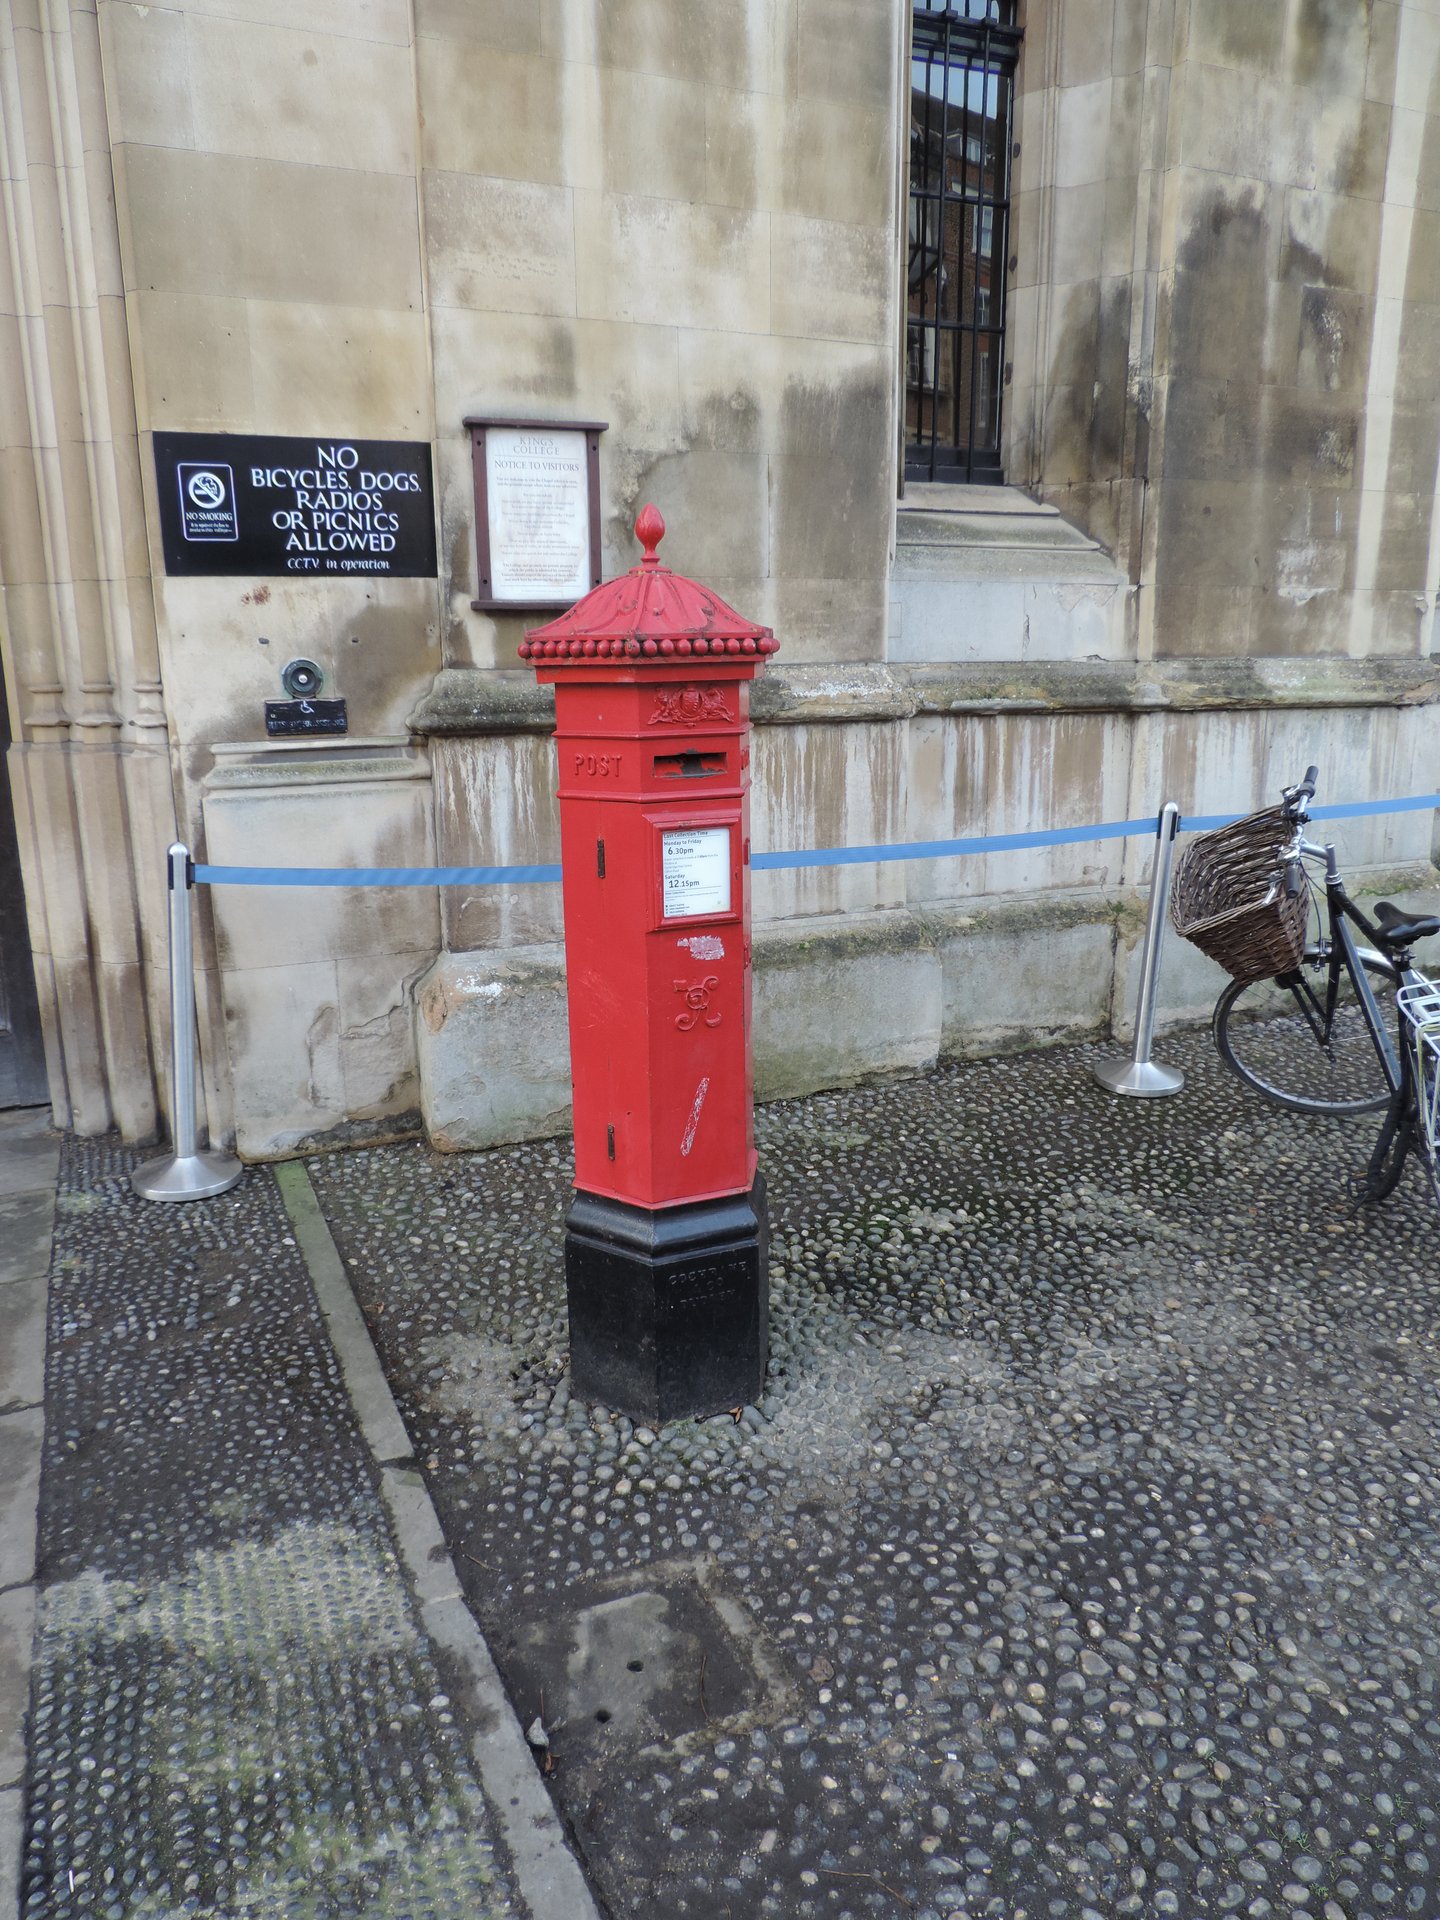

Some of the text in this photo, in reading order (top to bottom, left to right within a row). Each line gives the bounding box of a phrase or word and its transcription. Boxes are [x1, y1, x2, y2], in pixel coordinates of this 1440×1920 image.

[317, 446, 359, 470] NO
[513, 446, 560, 455] COLLEGE
[494, 460, 580, 472] NOTICE TO VISITORS
[360, 471, 422, 492] DOGS,
[297, 491, 383, 511] RADIOS
[186, 512, 233, 521] NO SMOKING
[272, 511, 400, 532] OR PICNICS
[285, 532, 396, 552] ALLOWED
[326, 558, 338, 569] in
[340, 559, 390, 572] operation
[574, 753, 622, 777] POST
[667, 846, 694, 855] 6.30pm
[669, 879, 700, 889] 12.15pm
